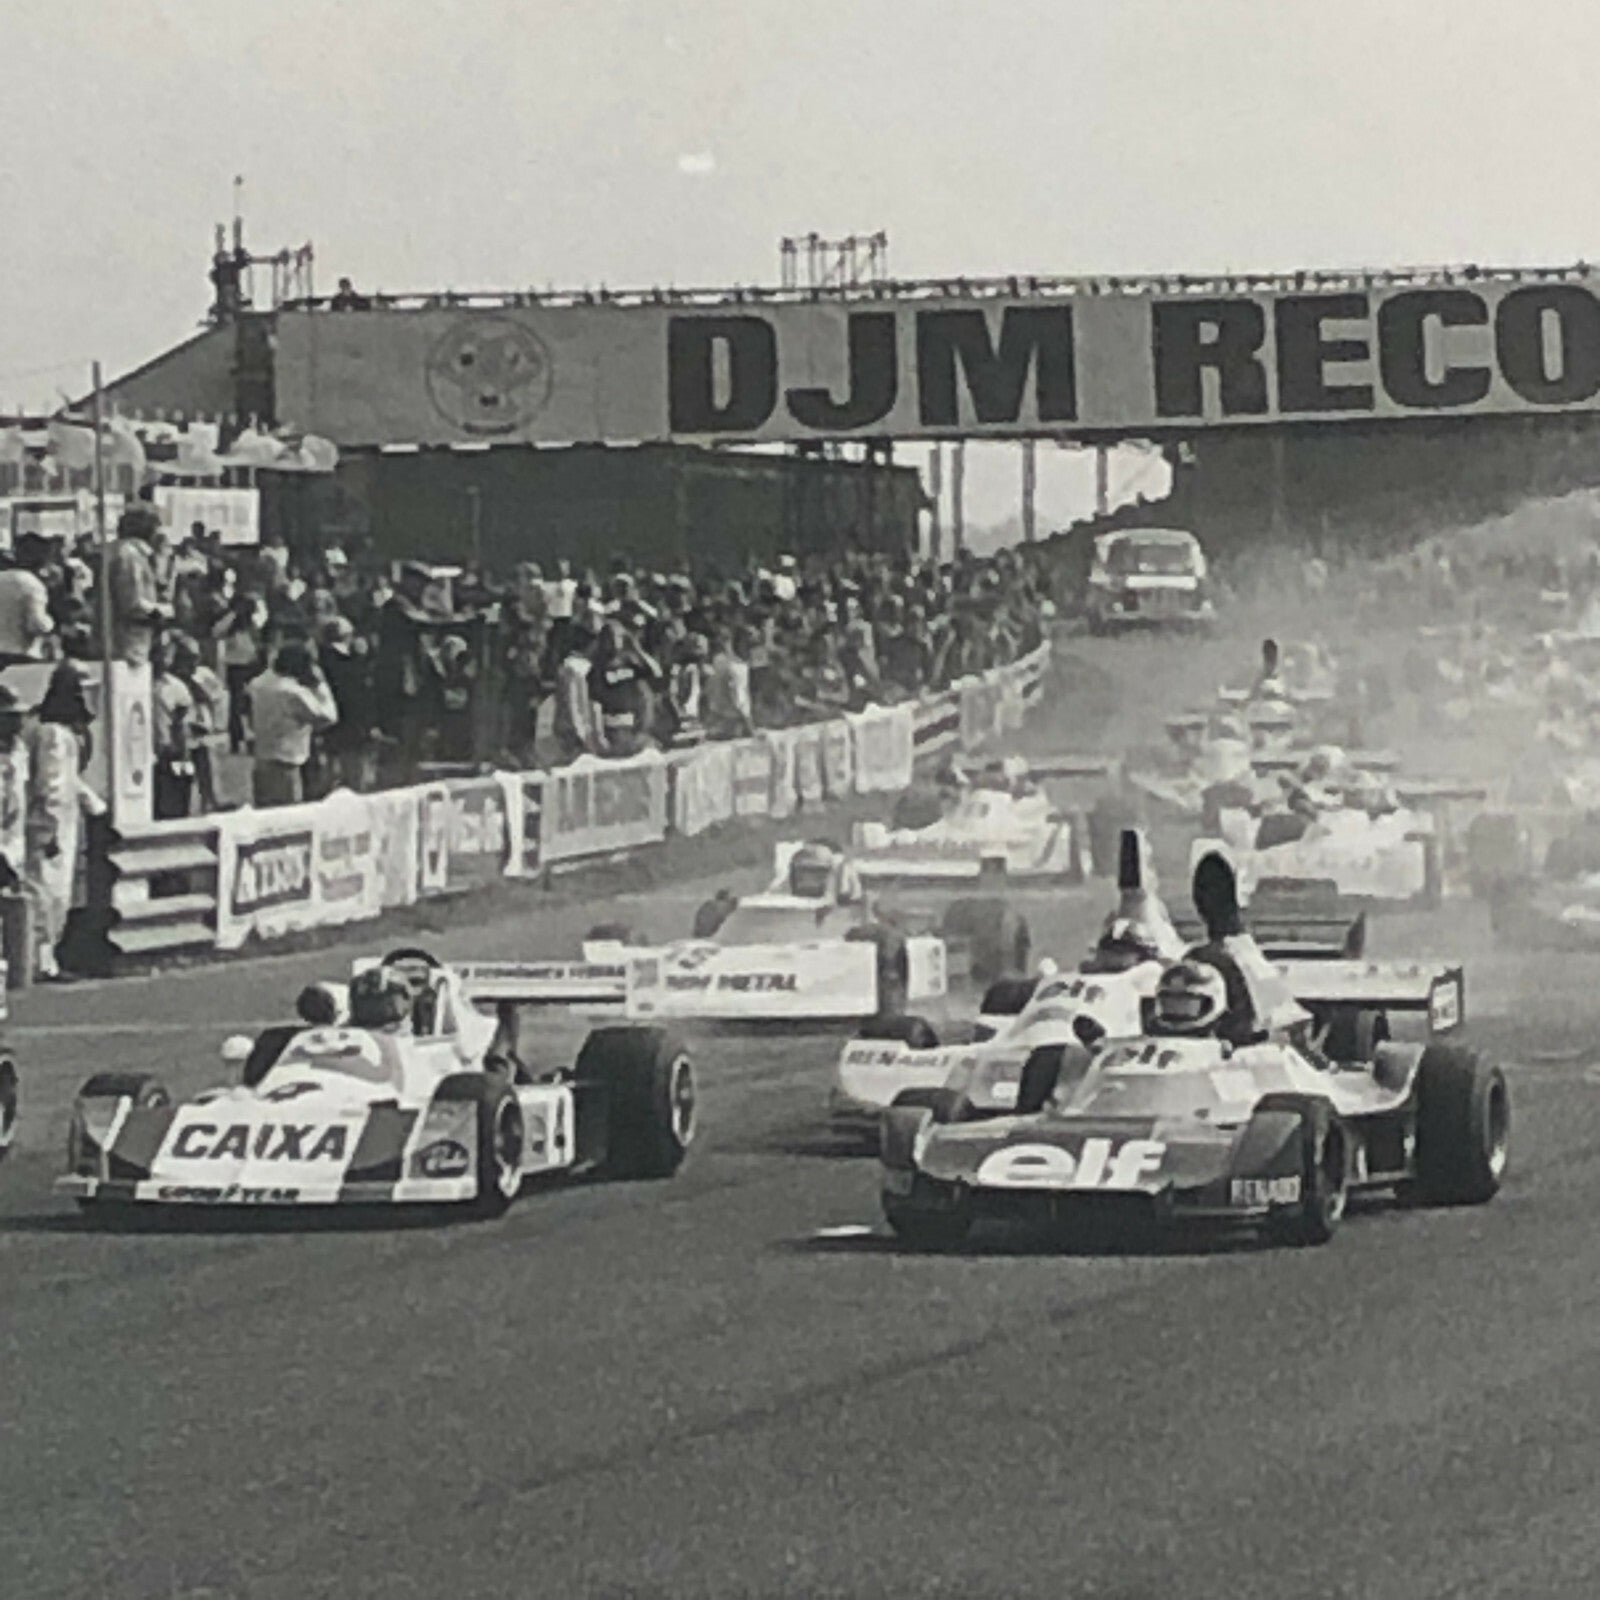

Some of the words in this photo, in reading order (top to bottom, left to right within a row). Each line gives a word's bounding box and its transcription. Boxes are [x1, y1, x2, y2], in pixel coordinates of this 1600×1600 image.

[668, 305, 1078, 434] DJM
[1151, 284, 1600, 418] RECO
[171, 1123, 349, 1161] CAIXA
[976, 1137, 1166, 1188] elf
